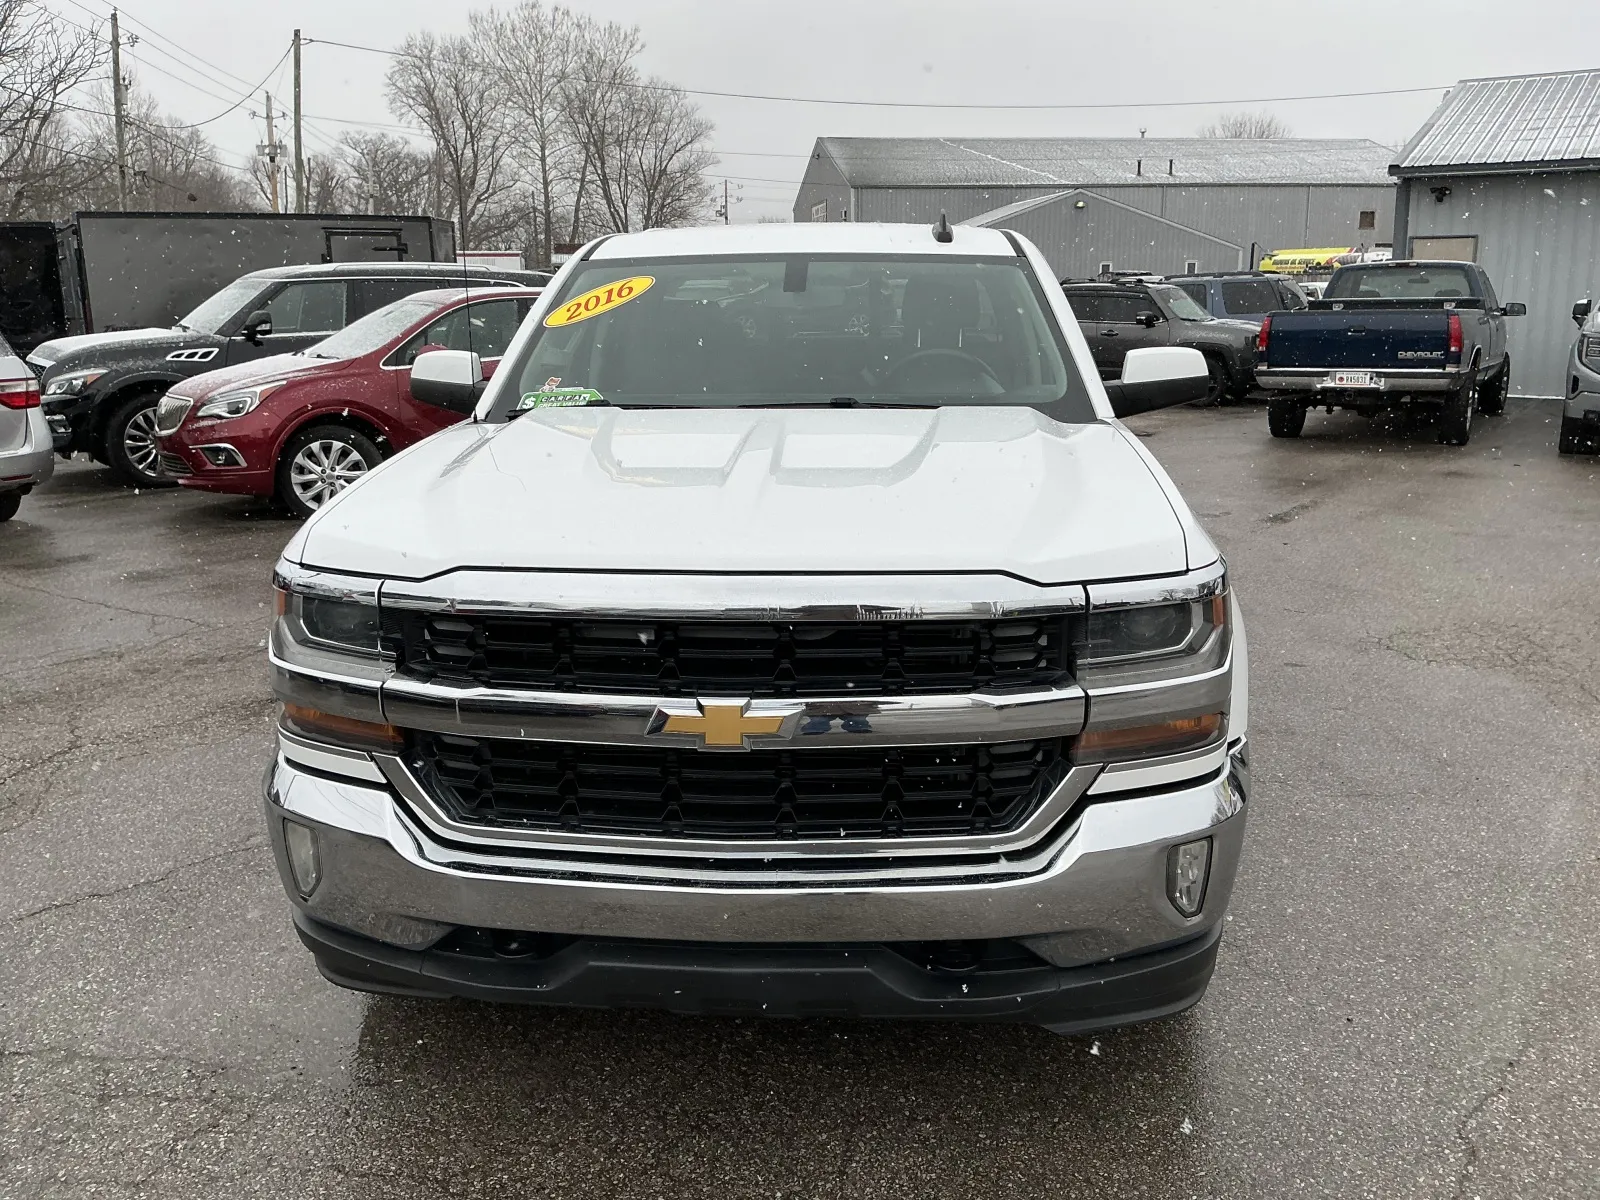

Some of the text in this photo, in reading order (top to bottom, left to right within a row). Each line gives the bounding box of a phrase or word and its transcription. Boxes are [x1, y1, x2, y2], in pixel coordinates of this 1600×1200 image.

[566, 280, 633, 321] 2016
[1397, 351, 1442, 359] CHEVROLET
[541, 394, 590, 402] CARFAX
